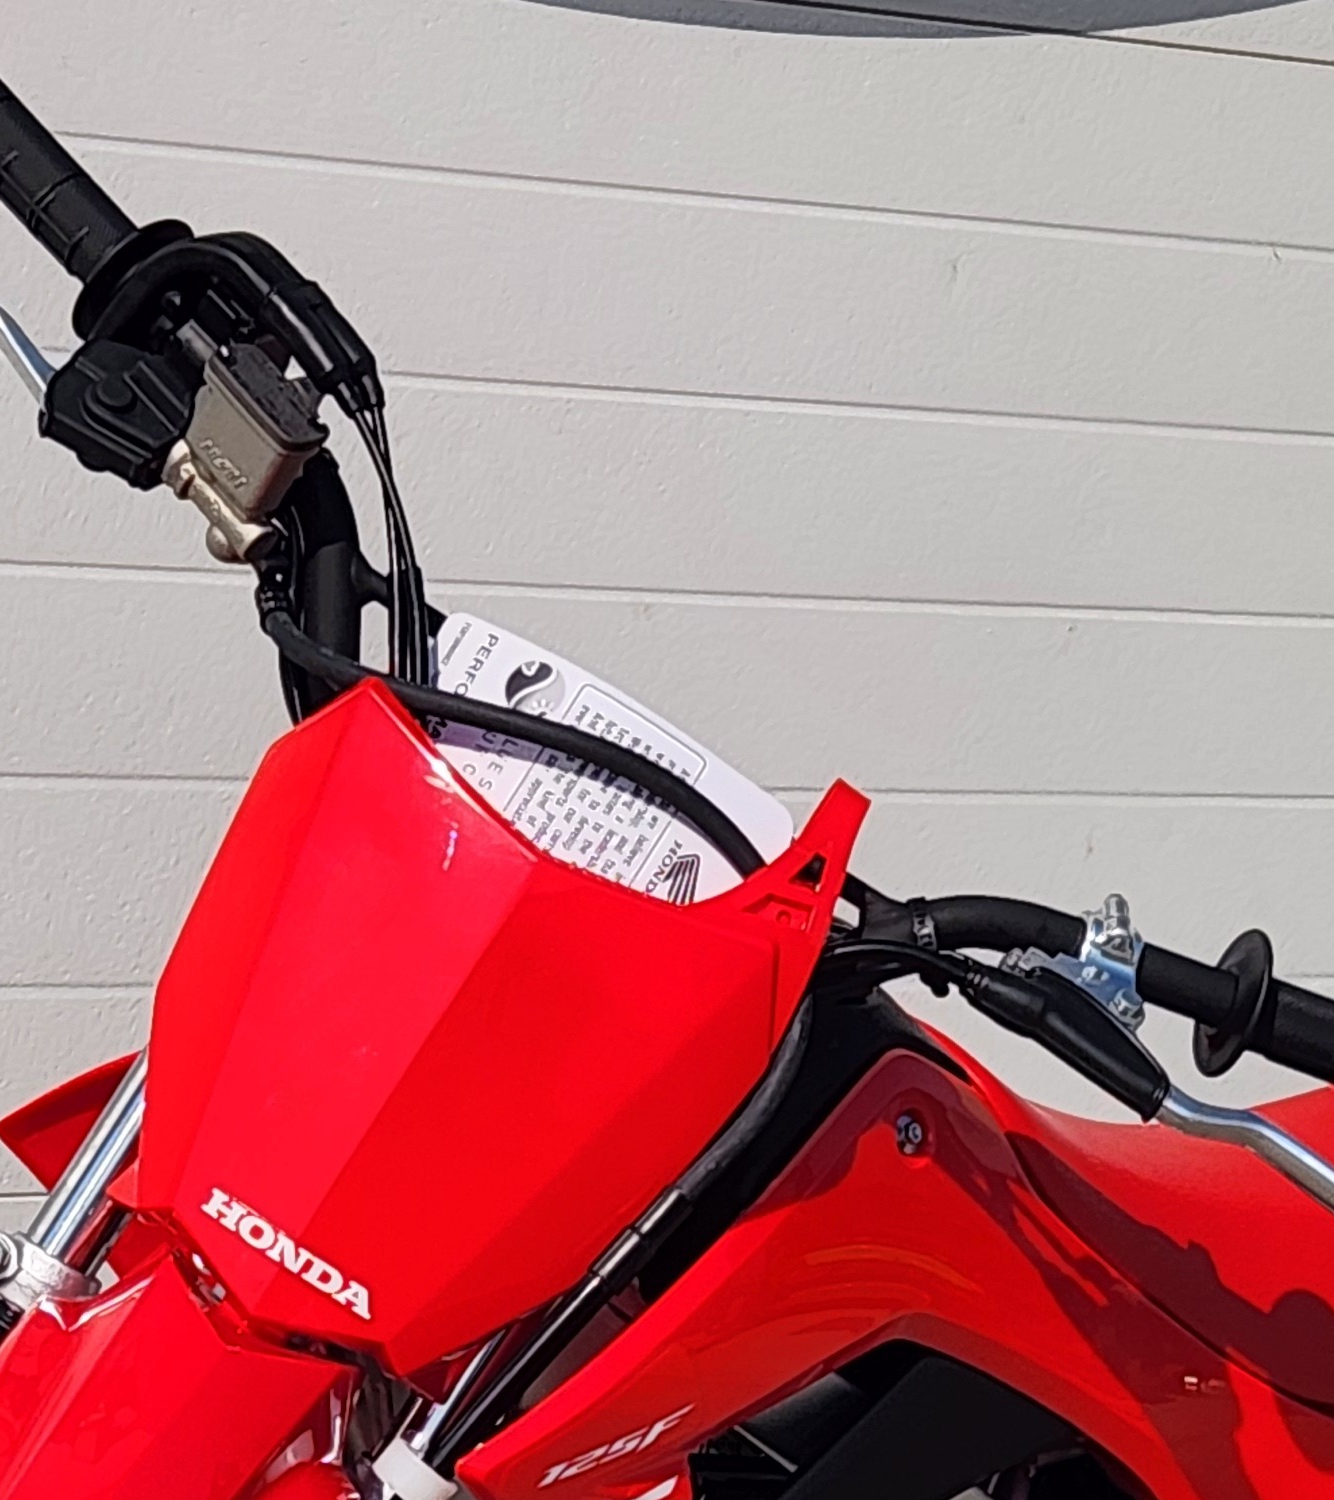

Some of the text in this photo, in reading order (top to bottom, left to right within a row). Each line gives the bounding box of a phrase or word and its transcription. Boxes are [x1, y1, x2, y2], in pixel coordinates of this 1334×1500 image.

[645, 839, 683, 894] HOND
[200, 1187, 372, 1320] HONDA
[537, 1402, 697, 1489] 125F
